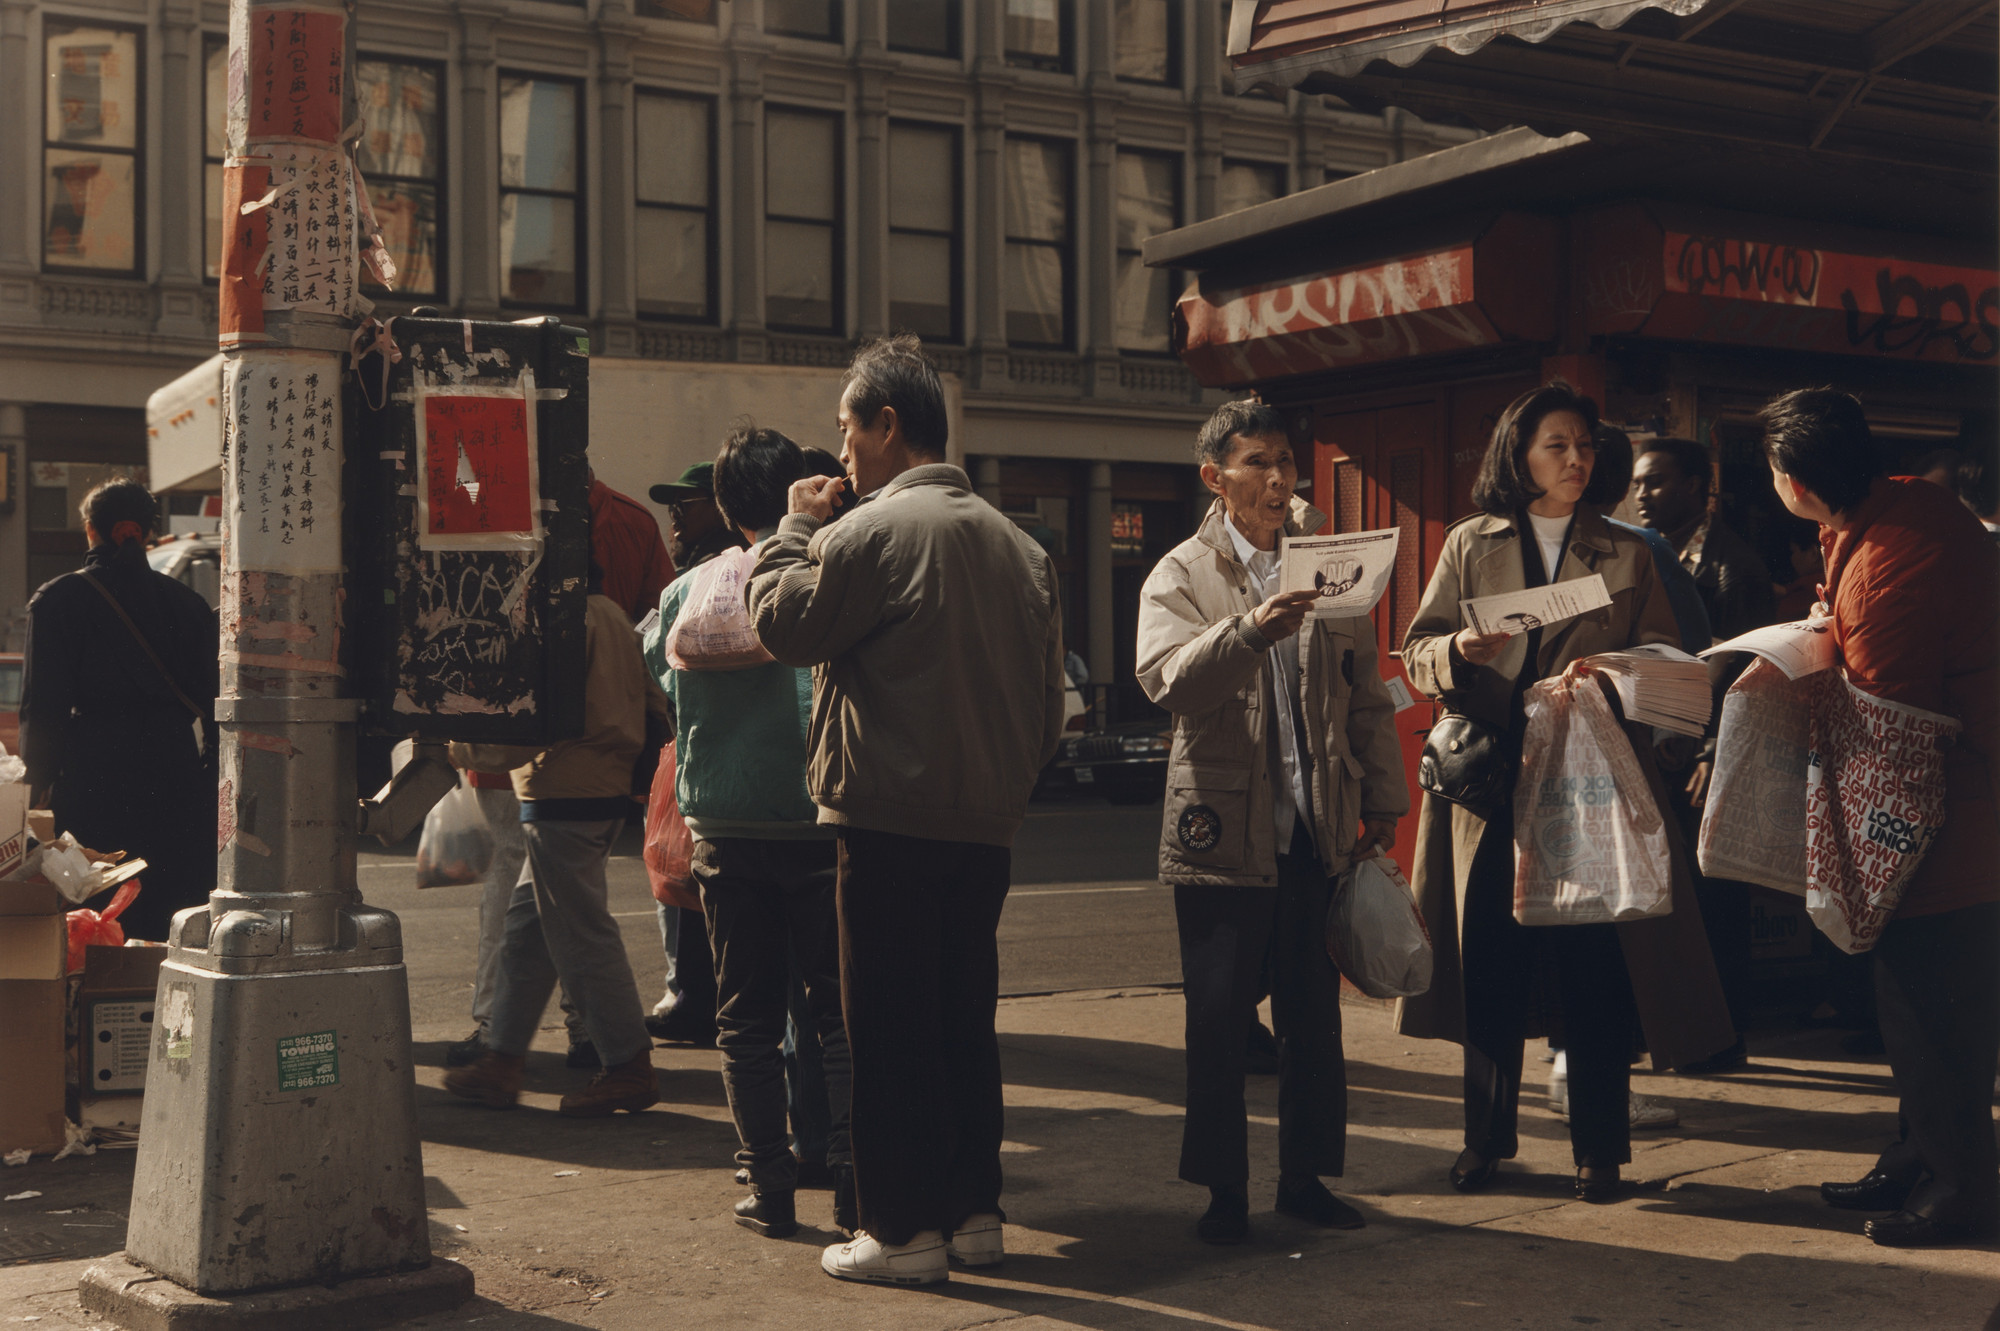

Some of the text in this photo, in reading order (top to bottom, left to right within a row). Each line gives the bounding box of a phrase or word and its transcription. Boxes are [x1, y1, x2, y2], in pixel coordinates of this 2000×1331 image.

[1851, 690, 1899, 725] ILGWU
[1868, 807, 1940, 841] LOOK FO
[1868, 824, 1922, 855] UNION
[1851, 832, 1905, 869] ILGWU
[280, 1042, 335, 1058] TOWING
[295, 1034, 332, 1046] 966-7370
[297, 1073, 335, 1087] 966-7370
